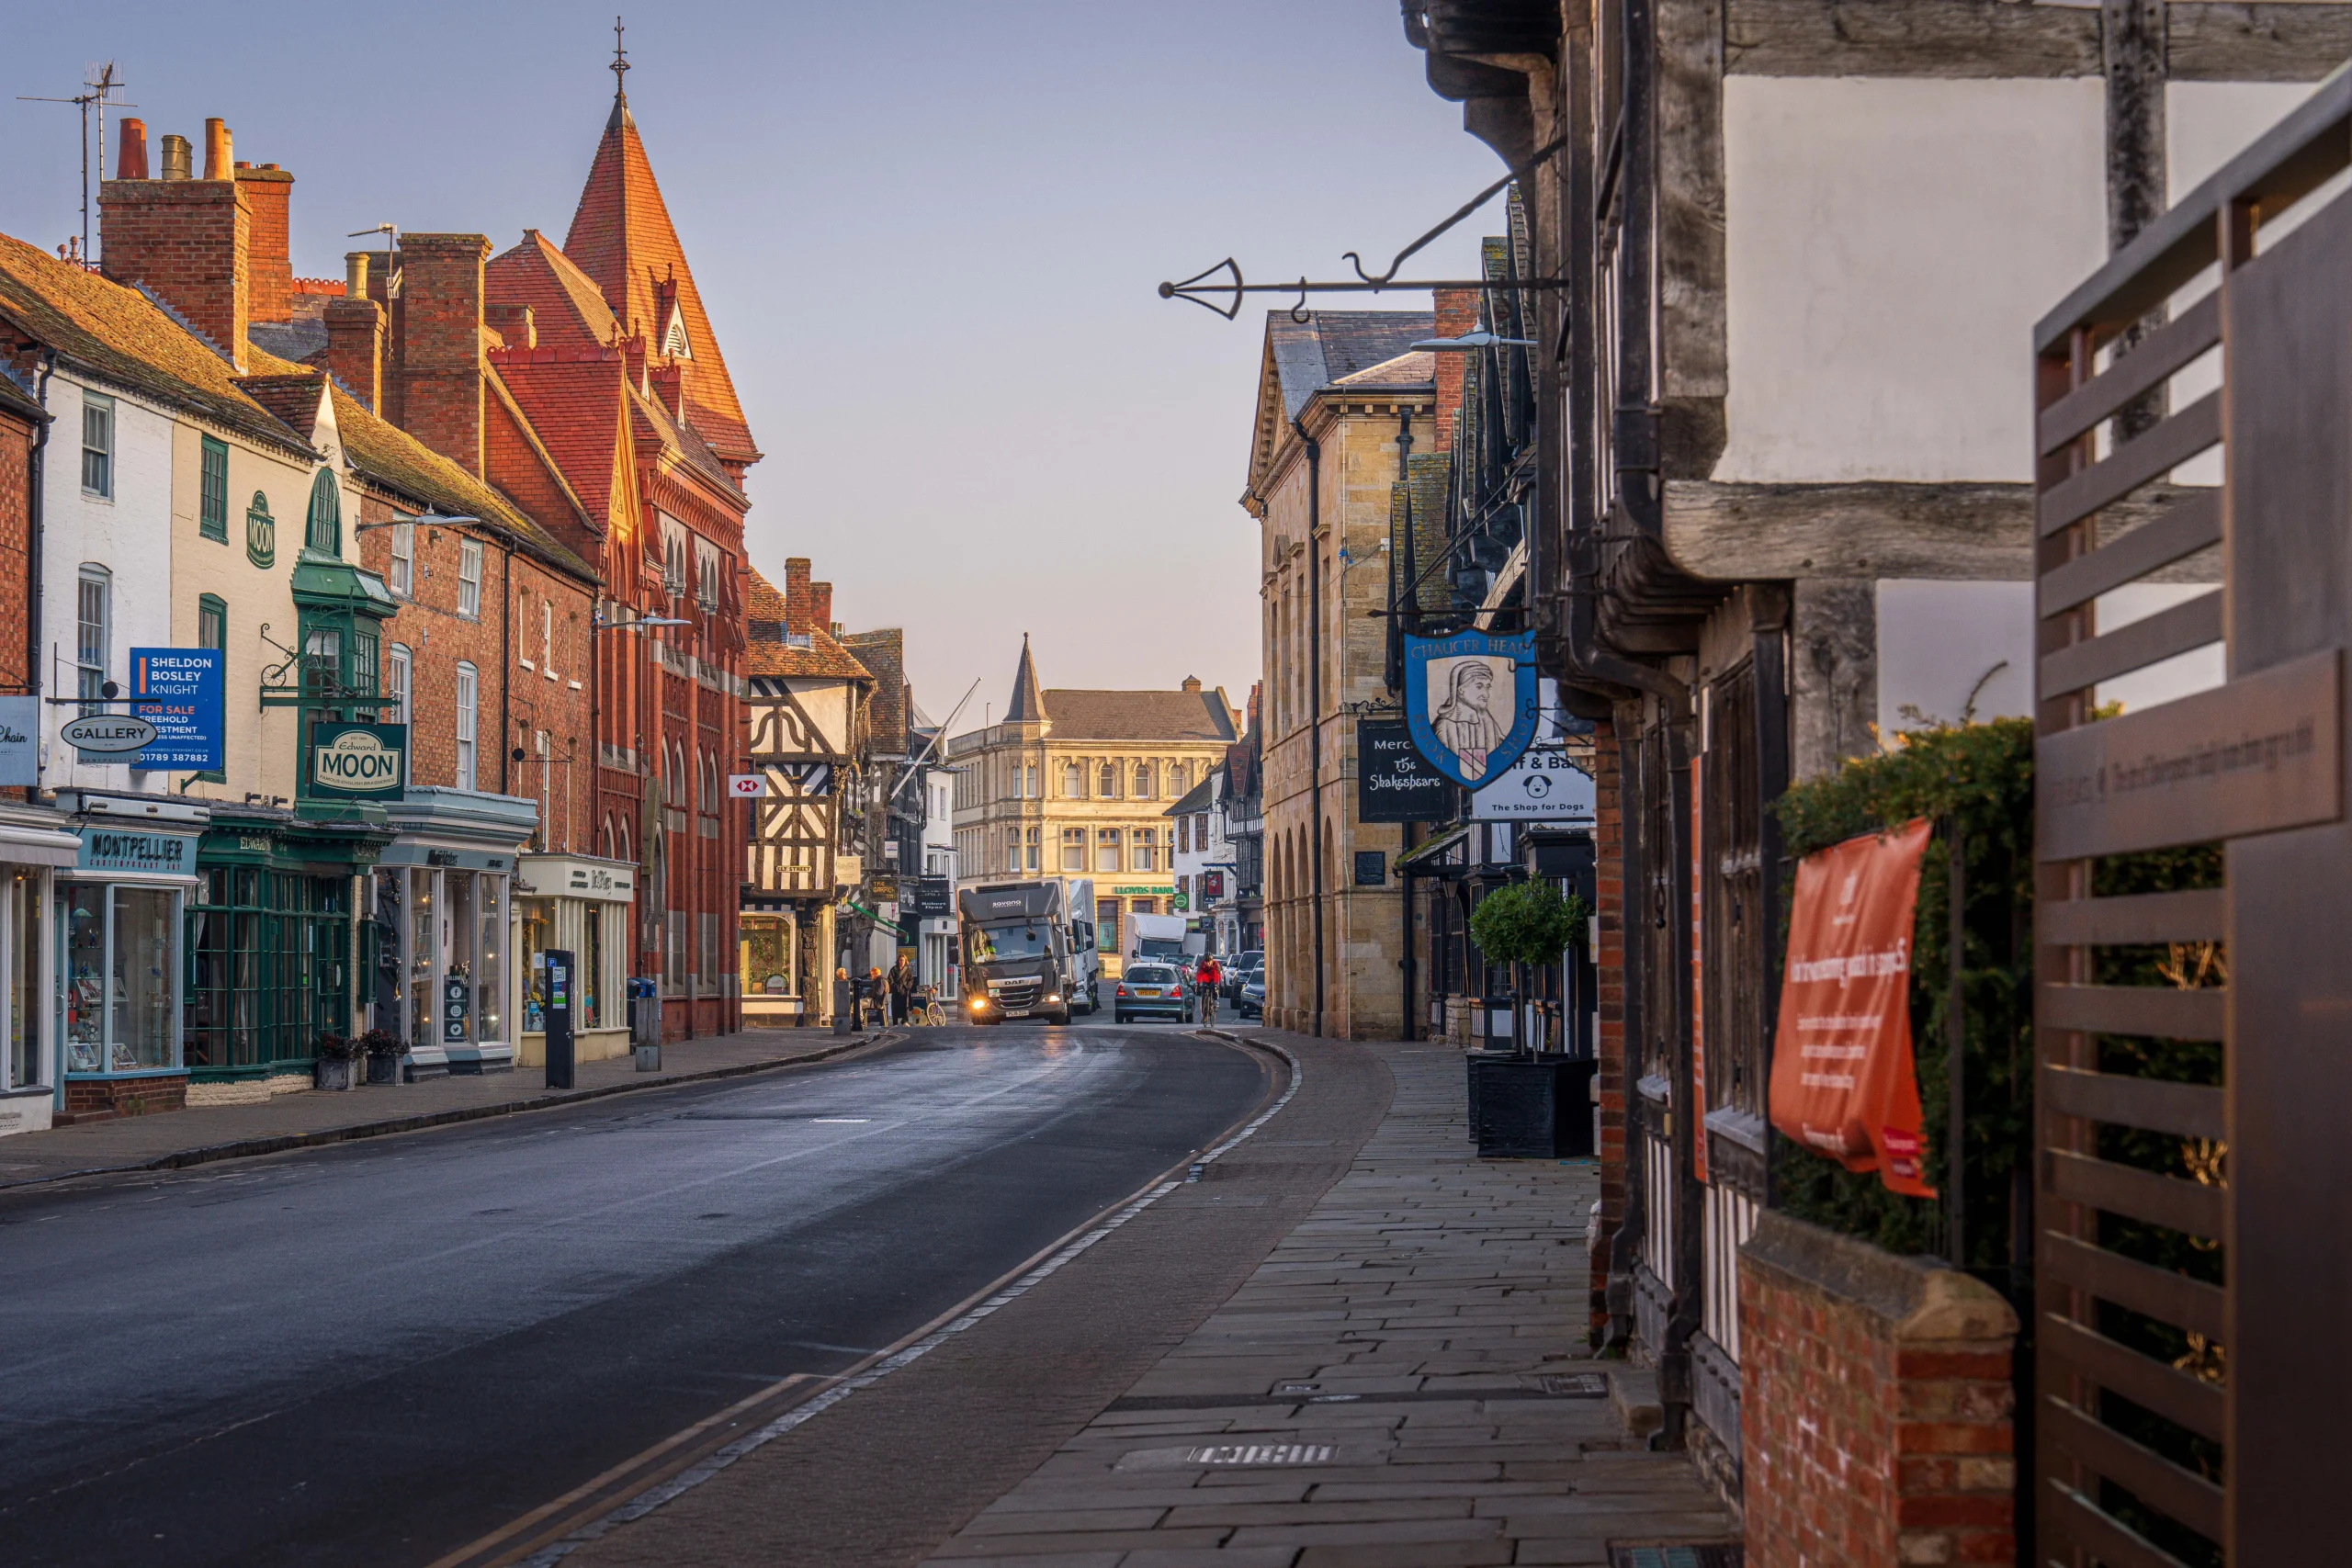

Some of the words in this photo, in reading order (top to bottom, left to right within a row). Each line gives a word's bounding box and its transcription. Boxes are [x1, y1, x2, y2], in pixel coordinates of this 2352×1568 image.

[249, 517, 273, 553] MOON
[1411, 639, 1480, 659] CHAUCER
[151, 657, 212, 669] SHELDON
[151, 671, 202, 682] BOSLEY
[151, 684, 198, 694] KNIGHT
[139, 705, 163, 714] FOR
[165, 705, 196, 715] SALE
[72, 728, 147, 739] GALLERY
[157, 726, 198, 734] ESTMENT
[1374, 739, 1414, 750] Merc
[1412, 714, 1450, 765] BOOK
[338, 741, 376, 751] Edward
[140, 753, 168, 761] 01789
[172, 754, 209, 762] 387882
[1530, 756, 1543, 770] &
[322, 752, 394, 779] MOON
[1394, 756, 1417, 773] The
[319, 774, 341, 784] FAMOUS
[1369, 773, 1441, 791] Shakespeare
[1513, 803, 1538, 812] Shop
[1559, 803, 1584, 812] Dogs
[91, 833, 183, 862] MONTPELLIER
[1114, 886, 1149, 895] LLOYDS
